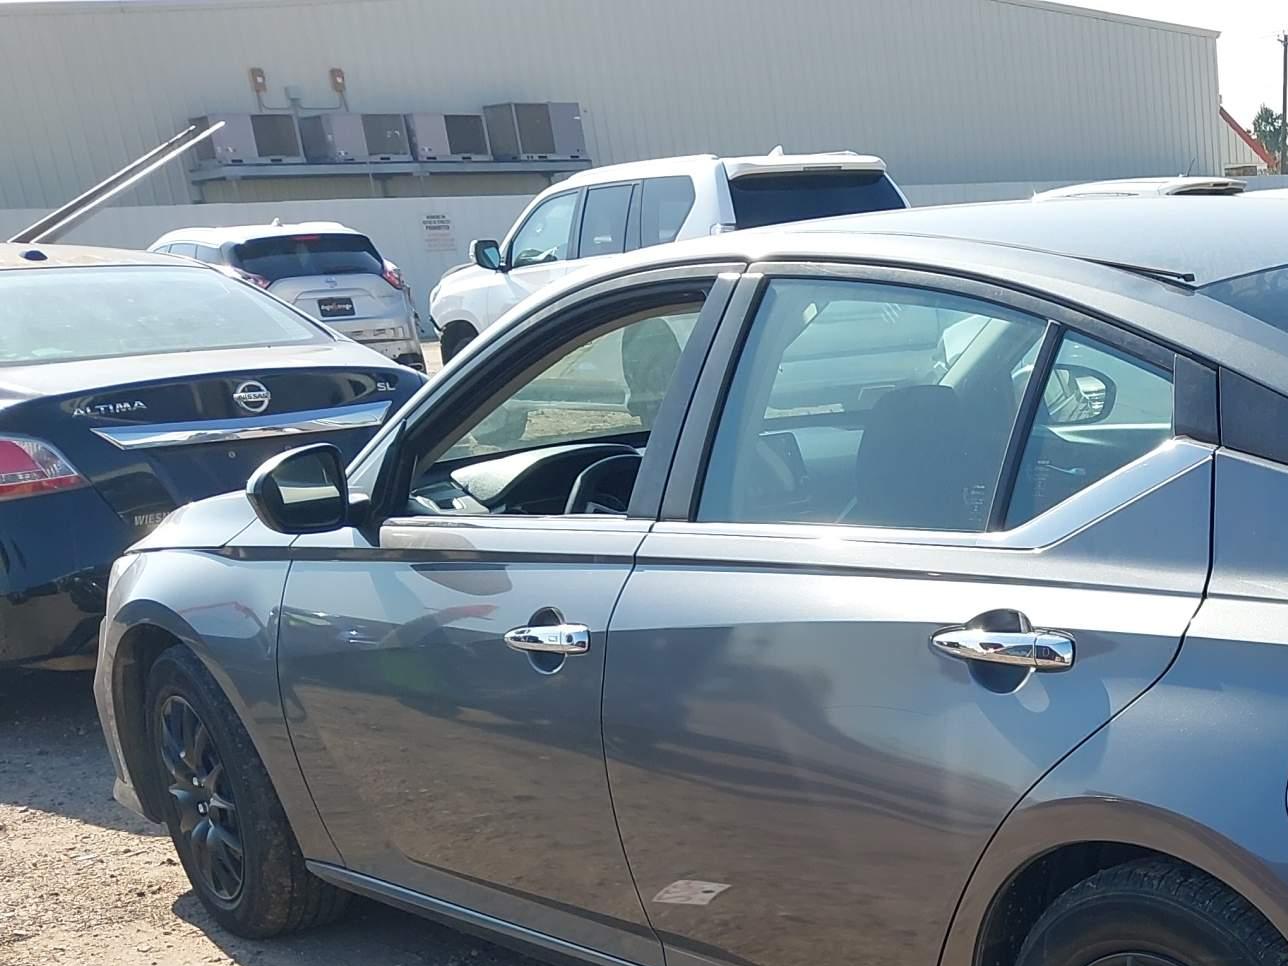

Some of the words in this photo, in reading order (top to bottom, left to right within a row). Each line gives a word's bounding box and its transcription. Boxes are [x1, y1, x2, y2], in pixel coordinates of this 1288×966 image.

[376, 382, 396, 391] SL
[239, 391, 269, 401] NISSAN
[72, 401, 147, 418] ALTIMA
